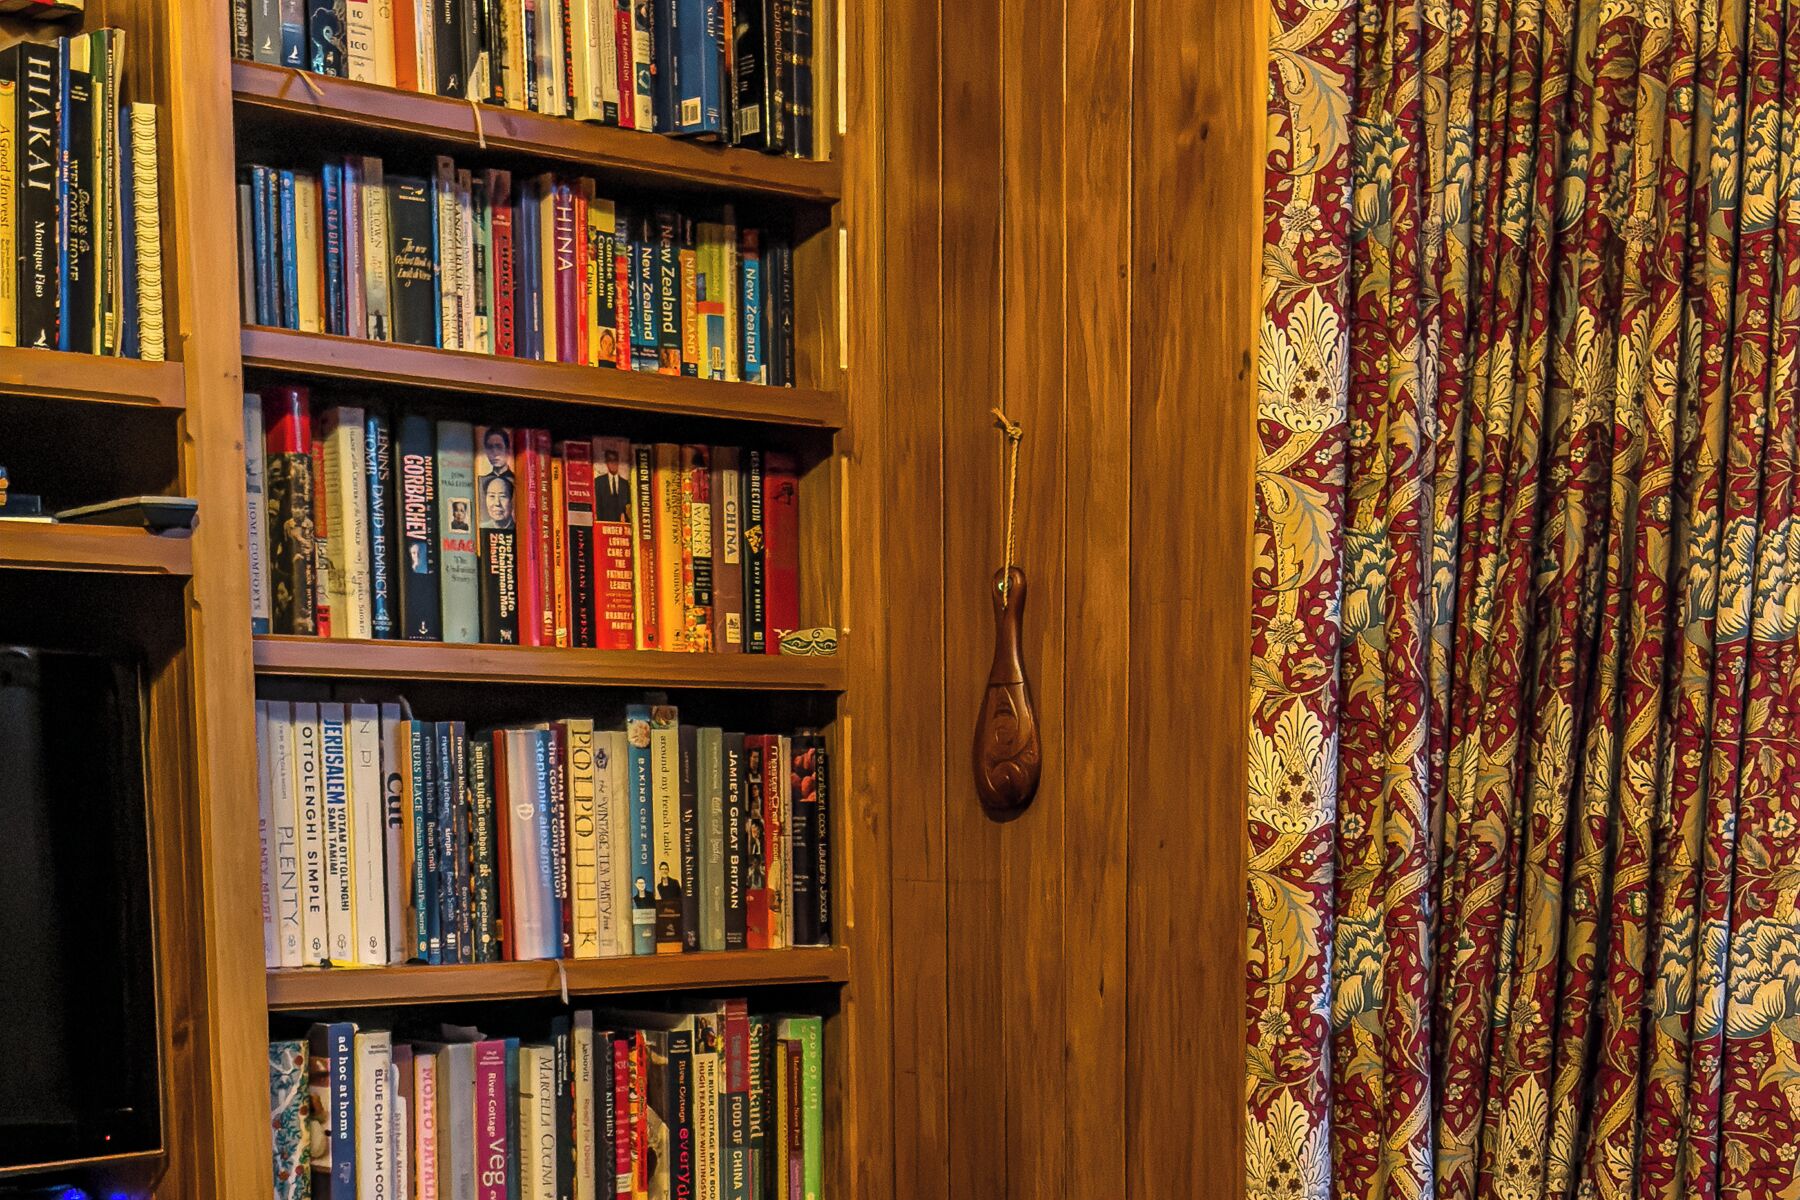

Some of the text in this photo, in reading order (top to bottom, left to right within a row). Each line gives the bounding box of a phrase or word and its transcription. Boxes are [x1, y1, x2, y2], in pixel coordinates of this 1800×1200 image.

[774, 3, 782, 76] confections
[28, 56, 51, 191] HIAKAI
[0, 142, 11, 172] Good
[0, 175, 11, 228] Harvest
[70, 159, 78, 281] WELCOME HOME
[33, 221, 45, 297] Monique Fiso
[661, 225, 676, 333] New Zealand
[641, 247, 654, 340] New Zealand
[686, 257, 696, 354] NEW ZEALAND
[746, 268, 757, 363] New Zealand
[503, 305, 511, 350] CUTS
[365, 433, 376, 474] TOMB
[377, 428, 389, 481] LENIN'S
[425, 456, 433, 501] MIKHAIL
[403, 454, 427, 540] GORBACHEV
[639, 453, 650, 540] SIMON WINCHESTER
[372, 484, 387, 600] DAVID REMNICK
[490, 533, 499, 574] Zhisui Li
[602, 525, 623, 536] UNDER
[607, 548, 624, 558] CARE
[693, 505, 702, 554] WAKES
[726, 501, 737, 556] CHINA
[249, 502, 261, 610] HOME COMFORTS
[498, 533, 508, 618] of Chairman Mao
[577, 529, 586, 588] JONATHAN
[615, 559, 626, 569] THE
[507, 592, 515, 611] Life
[324, 720, 345, 804] JERUSALEM
[412, 732, 421, 773] FLEURS
[441, 736, 449, 780] riverstone
[535, 739, 547, 813] stephanie
[729, 750, 739, 803] JAMIE'S
[413, 776, 422, 812] PLACE
[425, 736, 436, 872] riverstone kitchen Bevan Smith
[442, 782, 451, 814] kitchen
[458, 776, 466, 806] kitchen
[475, 746, 486, 814] smitten kitchen
[572, 731, 594, 838] POLPO
[637, 757, 646, 803] BAKING
[660, 735, 673, 856] around my french table
[302, 726, 320, 913] OTTOLENGHI SIMPLE
[328, 807, 338, 876] SAMI TAMIMI
[416, 816, 424, 846] Graham
[547, 741, 562, 898] the cook's companion
[730, 806, 739, 850] GREAT
[277, 827, 298, 927] PLENTY
[338, 807, 349, 911] YOTAM OTTOLENGHI
[684, 809, 695, 897] My Paris Kitchen
[417, 879, 425, 893] and
[730, 855, 740, 909] BRITAIN
[819, 886, 828, 923] Jacobs
[447, 897, 455, 921] Smith
[338, 1036, 349, 1140] ad hoc at home
[374, 1068, 384, 1101] BLUE
[488, 1072, 497, 1097] River
[679, 1060, 687, 1084] River
[698, 1061, 706, 1088] HUGH
[748, 1023, 763, 1139] Samarkand
[374, 1103, 384, 1144] CHAIR
[488, 1100, 497, 1138] Cottage
[539, 1056, 555, 1186] MARCELLA CUCINA
[679, 1086, 687, 1124] Cottage
[375, 1147, 384, 1171] JAM
[422, 1068, 436, 1200] MOLTO BATALI
[731, 1096, 743, 1190] FOOD OF CHINA
[482, 1138, 505, 1187] veg
